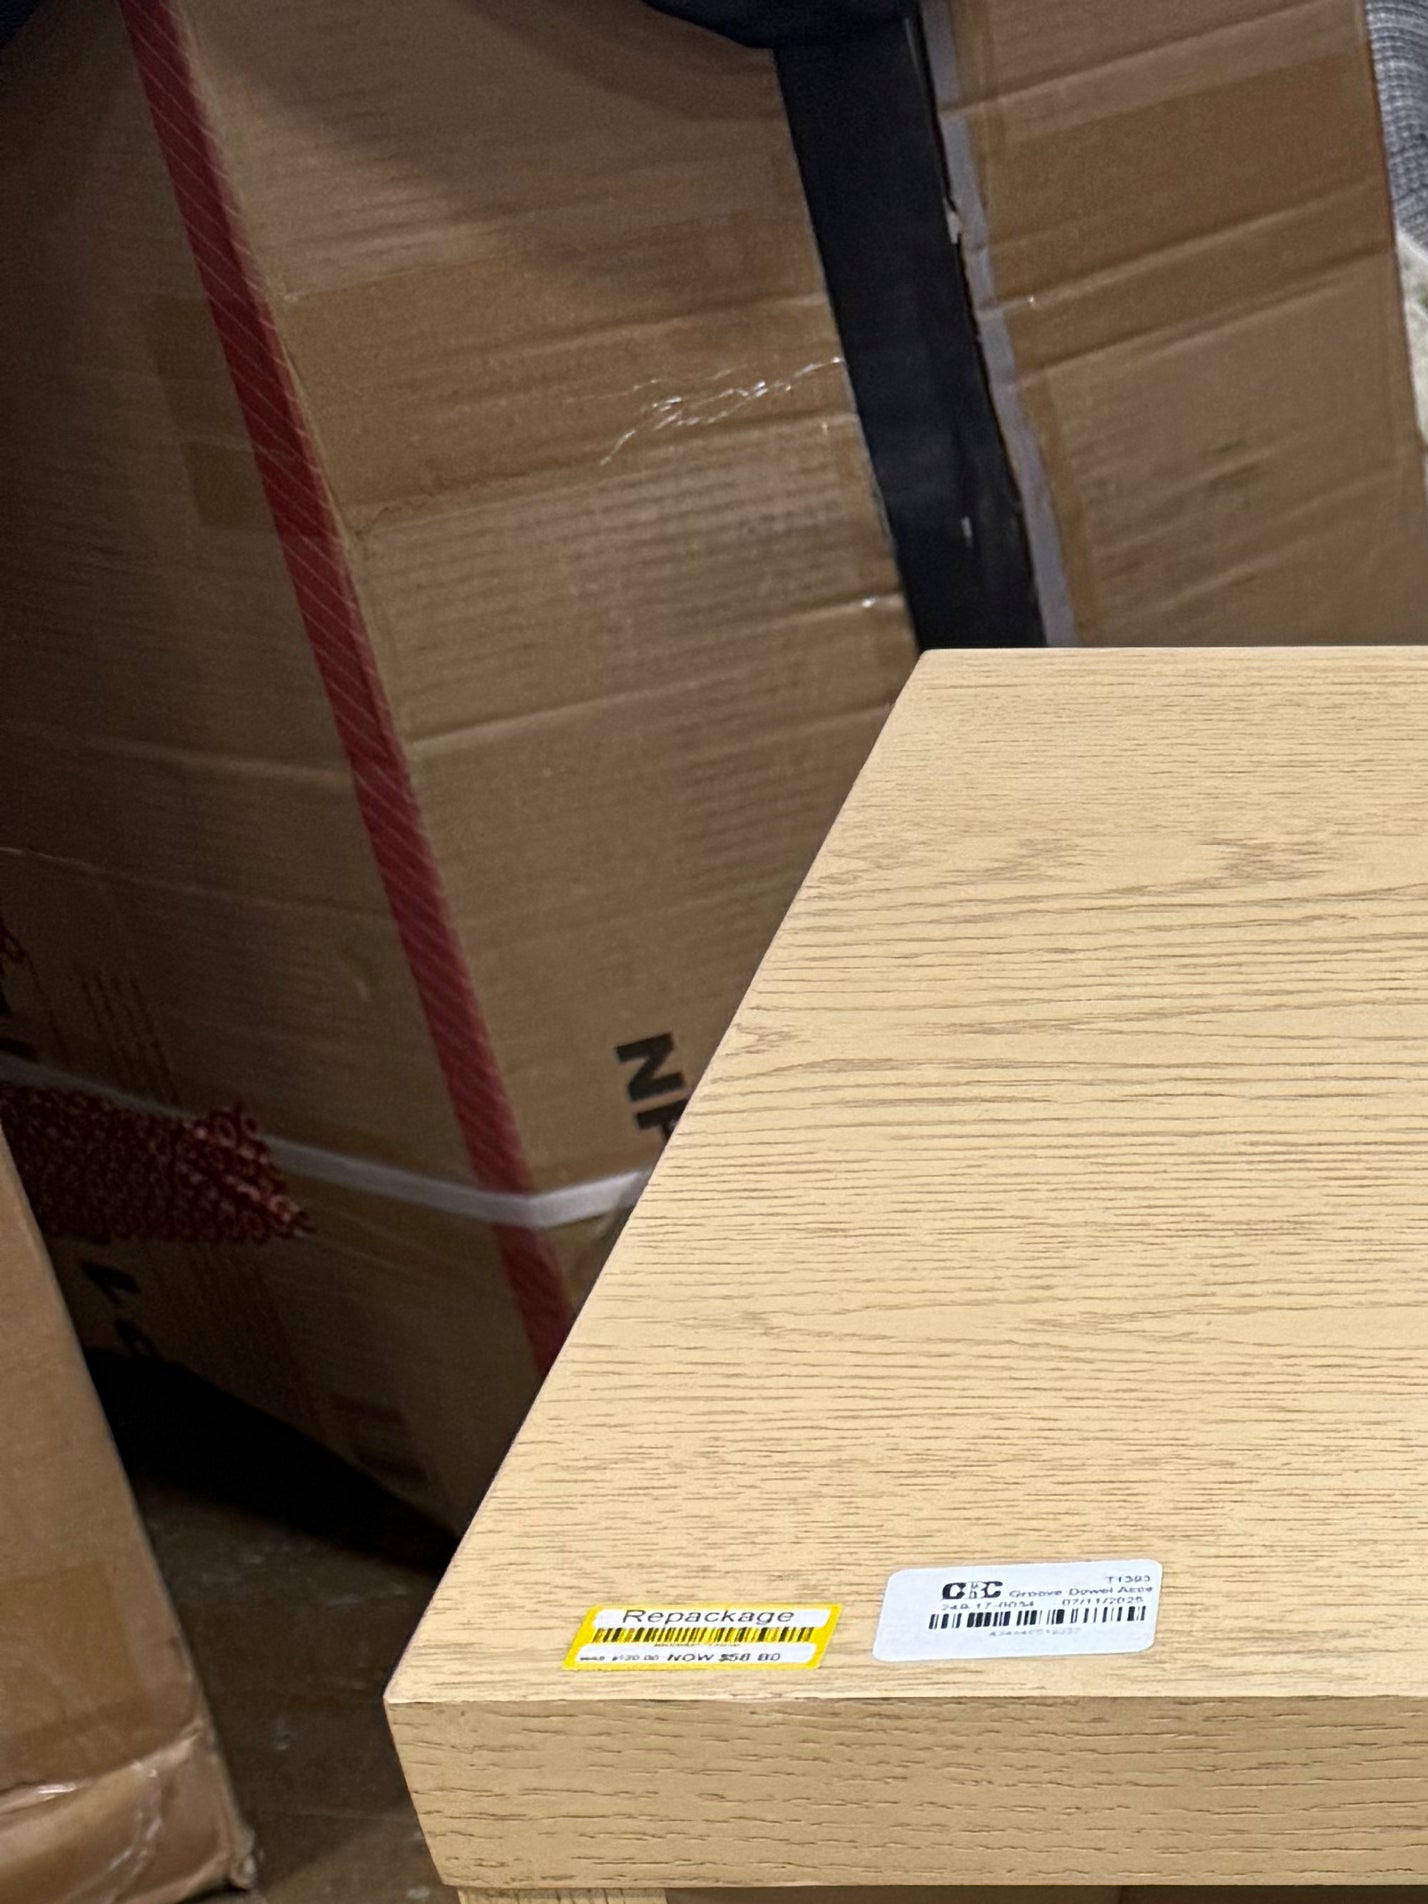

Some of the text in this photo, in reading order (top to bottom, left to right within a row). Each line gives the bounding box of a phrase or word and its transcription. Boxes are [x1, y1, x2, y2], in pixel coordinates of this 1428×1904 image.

[1009, 1590, 1062, 1598] Groove
[623, 1609, 795, 1627] Repackage
[667, 1653, 713, 1662] NOW
